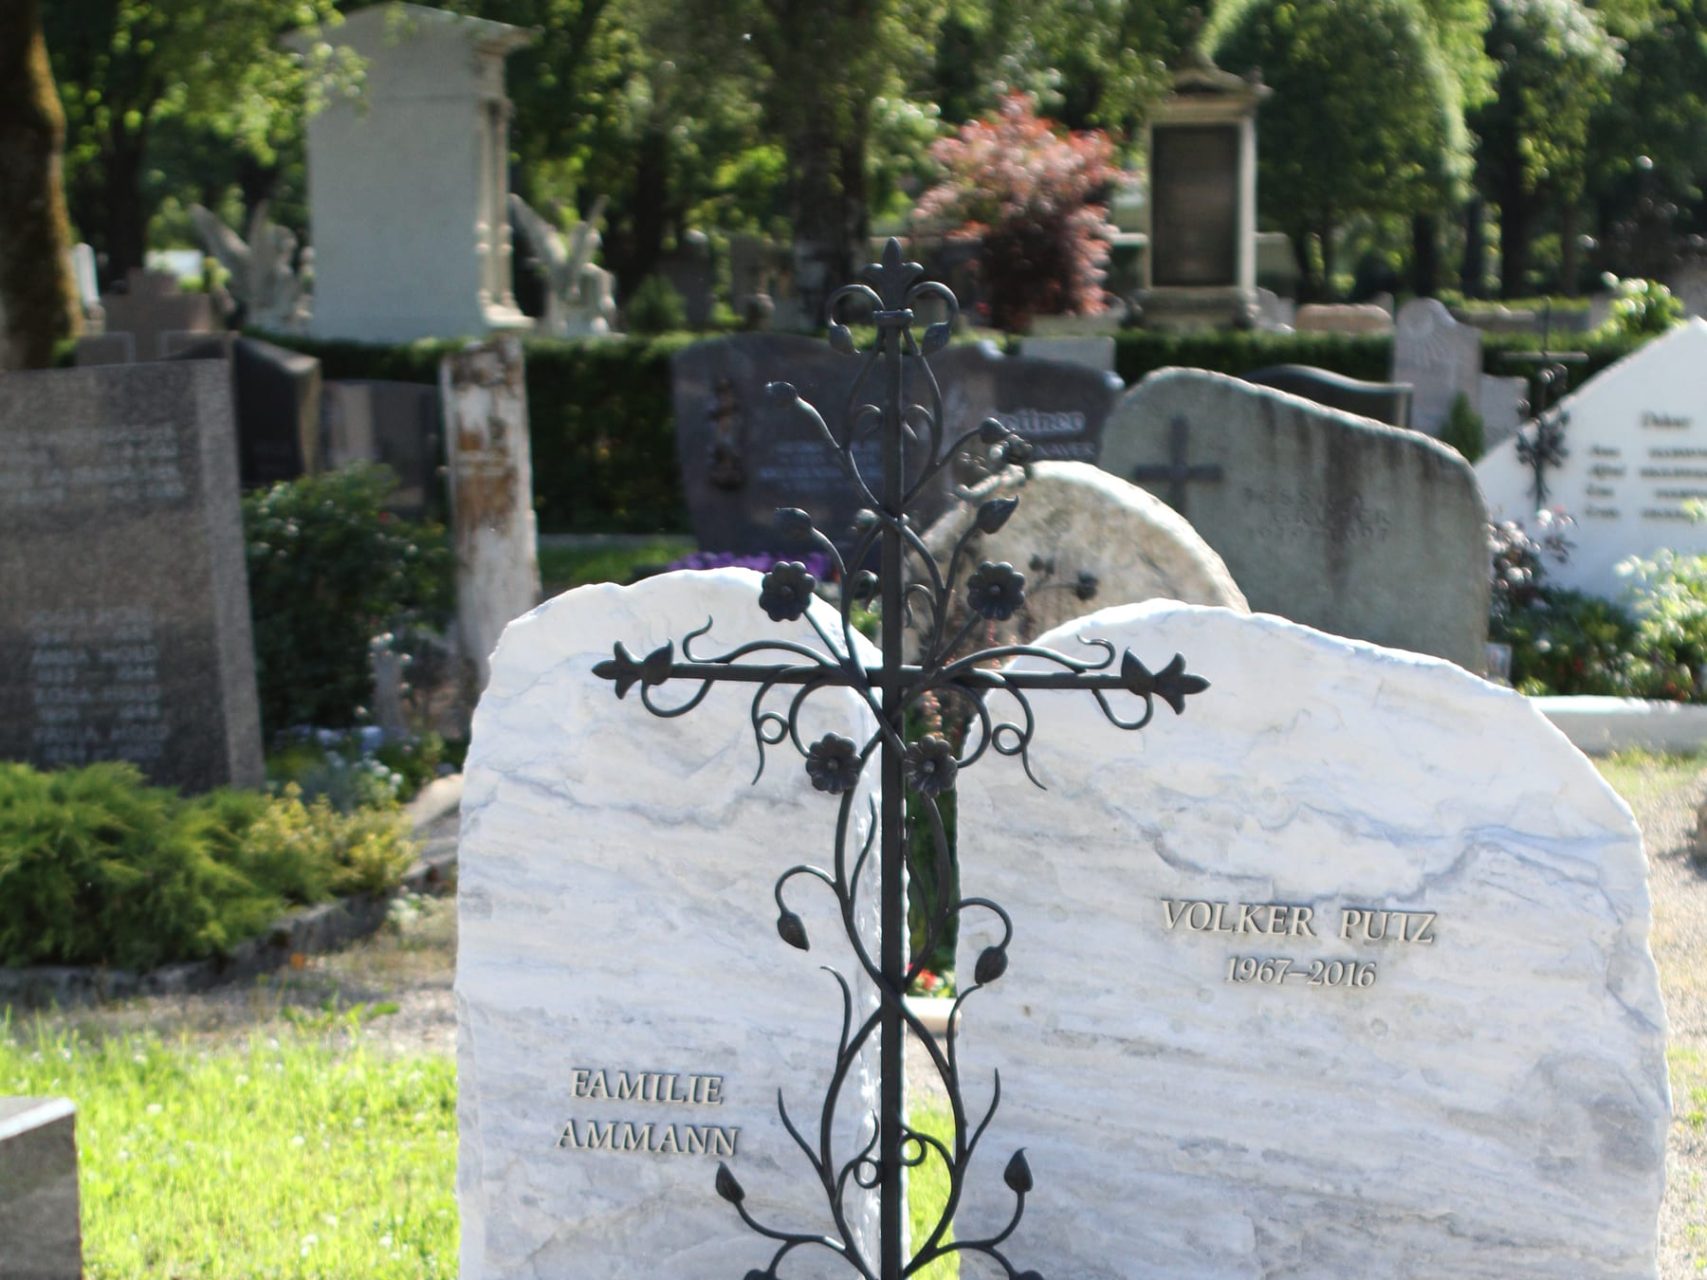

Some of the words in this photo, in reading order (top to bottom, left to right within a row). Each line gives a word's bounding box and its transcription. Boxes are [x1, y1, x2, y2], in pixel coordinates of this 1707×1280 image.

[1160, 899, 1316, 938] VOLKER
[1338, 907, 1438, 945] PUTZ
[1226, 955, 1378, 989] 1967-2016
[570, 1067, 725, 1105] FAMILIE
[556, 1118, 742, 1158] AMMANN
